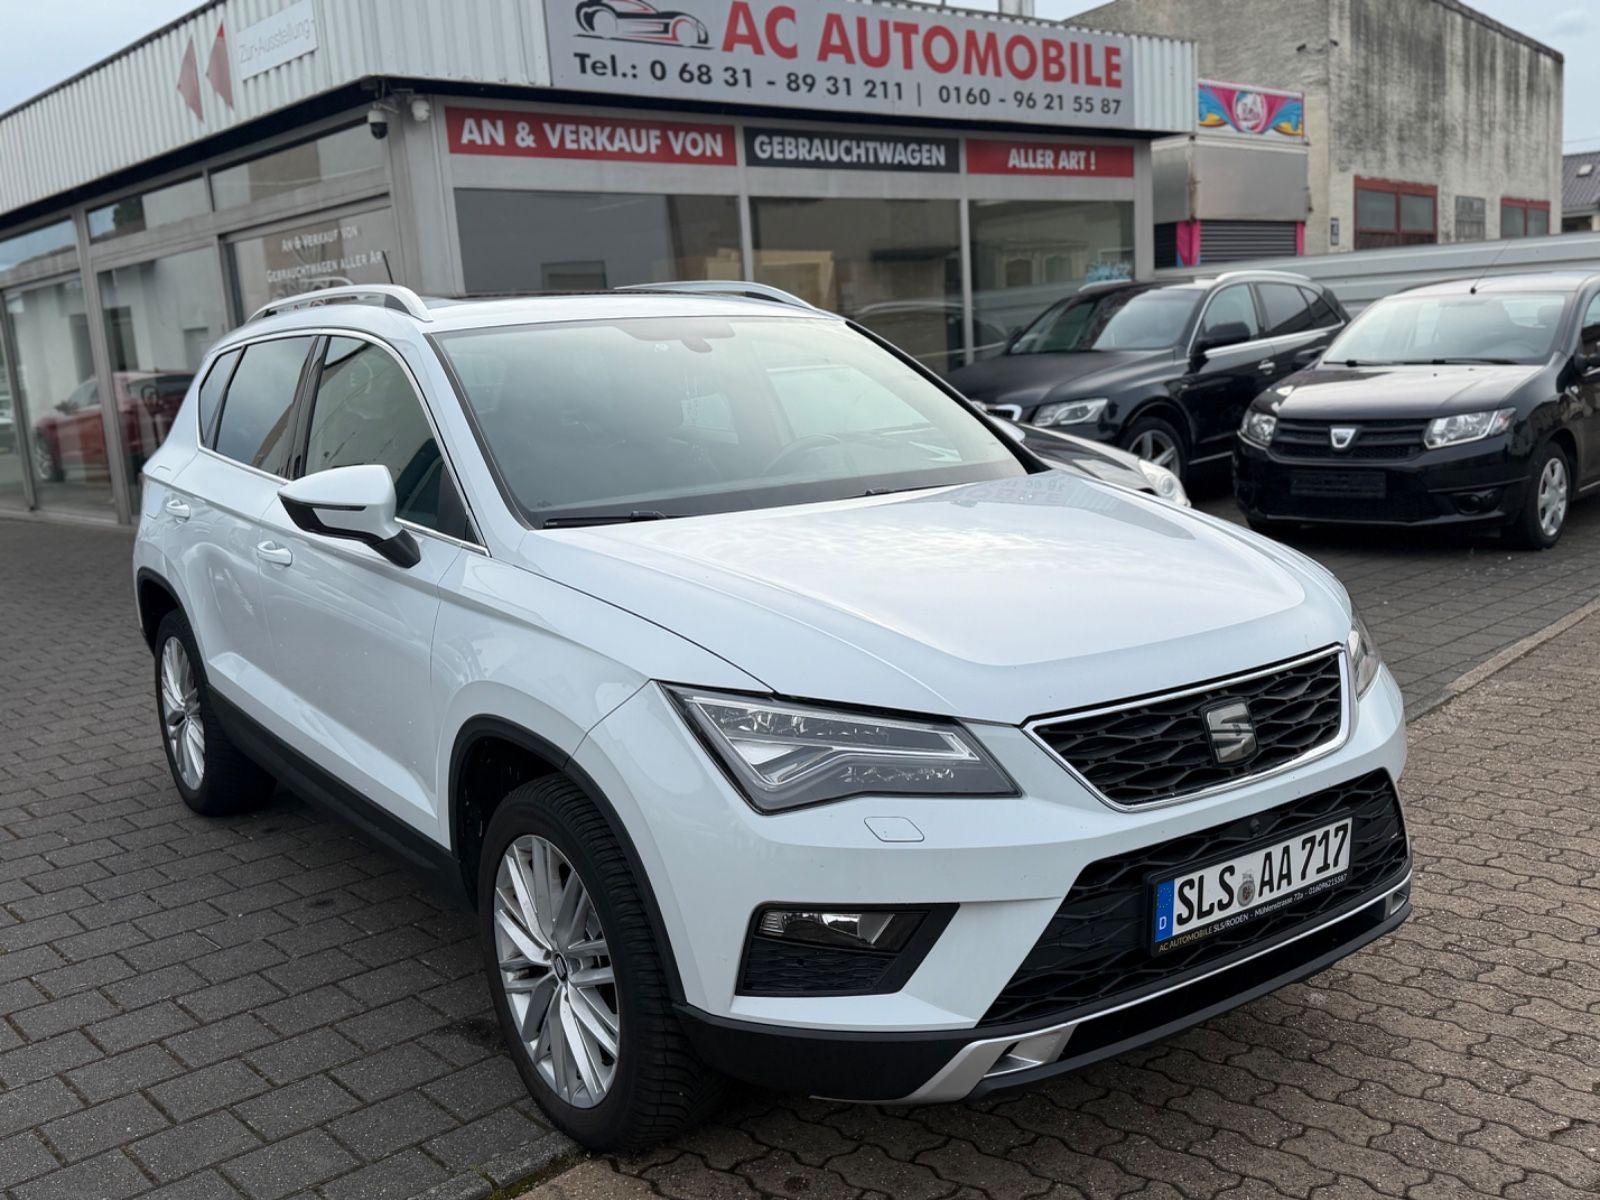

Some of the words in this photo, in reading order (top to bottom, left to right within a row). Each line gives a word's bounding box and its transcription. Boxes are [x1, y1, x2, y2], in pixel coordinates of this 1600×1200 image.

[721, 1, 798, 59] AC
[817, 13, 1122, 88] AUTOMOBILE
[574, 52, 638, 79] Tel.:
[650, 60, 667, 81] 0
[679, 63, 713, 85] 68
[723, 66, 752, 88] 31
[786, 72, 816, 93] 89
[826, 76, 852, 96] 31
[864, 79, 903, 100] 211
[938, 85, 990, 106] 0160
[1013, 91, 1037, 109] 96
[1044, 93, 1064, 111] 21
[1073, 96, 1094, 113] 55
[1100, 98, 1121, 115] 87
[461, 118, 505, 146] AN
[515, 121, 537, 148] &
[543, 122, 662, 154] VERKAUF
[667, 130, 723, 157] VON
[754, 135, 946, 167] GEBRAUCHTWAGEN
[1007, 147, 1055, 170] ALLER
[1057, 150, 1086, 171] ART
[1090, 151, 1096, 171] !
[1159, 916, 1167, 931] D
[1176, 864, 1236, 926] SLS
[1258, 845, 1293, 898] AA
[1300, 823, 1349, 881] 717
[1158, 942, 1168, 953] AC
[1169, 928, 1214, 949] AUTOMOBILE
[1213, 913, 1249, 934] SLS/RODEN
